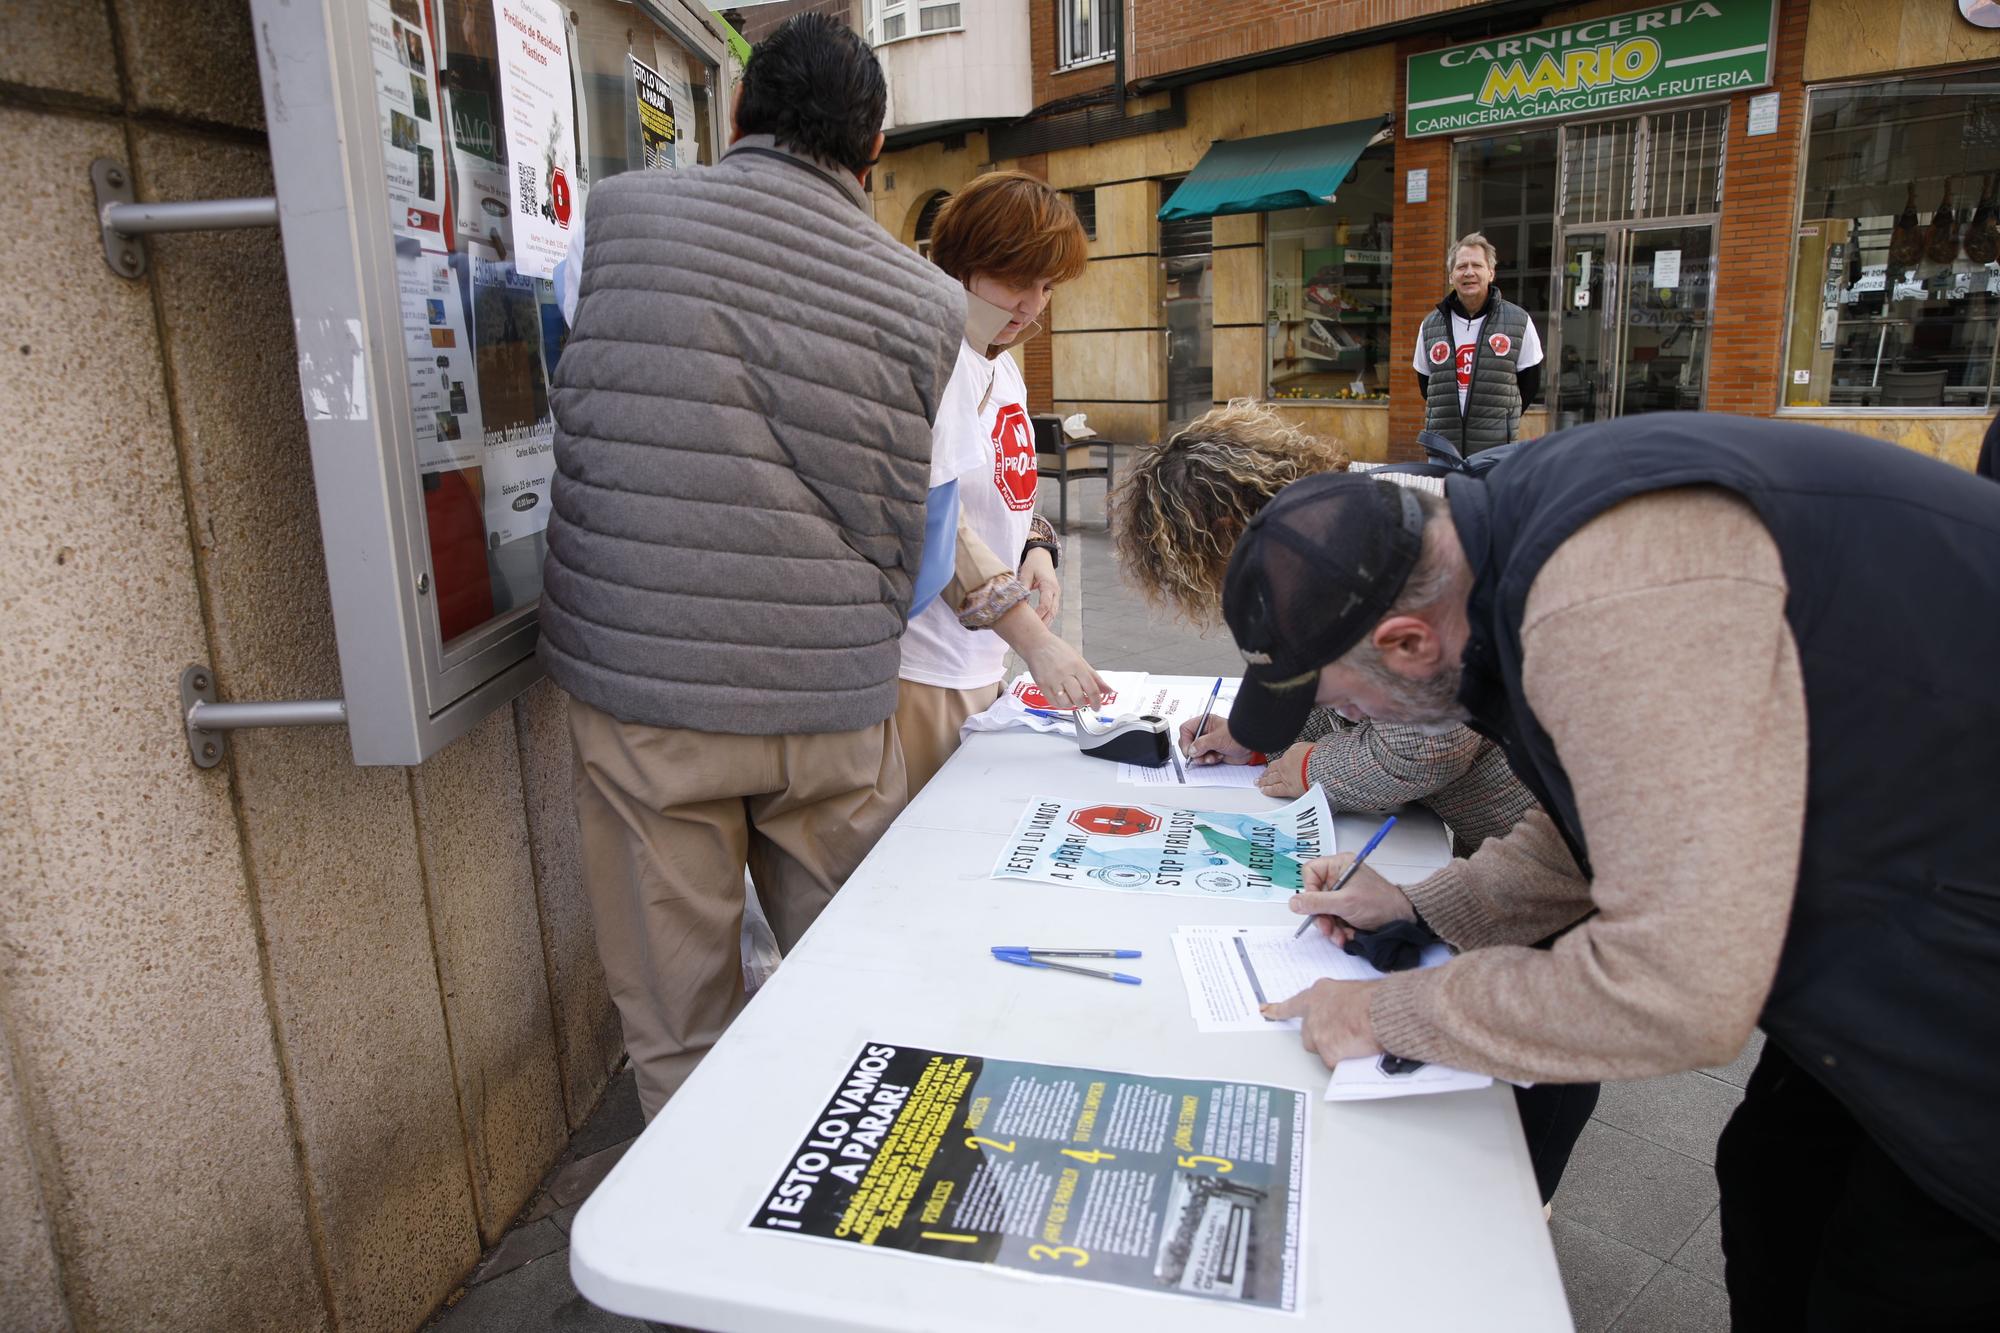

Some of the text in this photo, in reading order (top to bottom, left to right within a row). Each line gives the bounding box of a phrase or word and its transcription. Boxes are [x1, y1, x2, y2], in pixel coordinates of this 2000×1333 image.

[528, 25, 536, 39] de
[537, 30, 562, 56] Residuos
[1440, 2, 1722, 68] CARNICERIA
[522, 39, 548, 66] Plásticos
[1476, 35, 1661, 108] MARIO
[1415, 69, 1753, 133] CARNICERIA-CHARCUTERIA-FRUTERIA
[1005, 801, 1062, 873] ¡ESTO LO VAMOS
[1155, 812, 1196, 886] STOP PIRÓLISIS
[1296, 806, 1321, 860] QUEMAN
[1050, 832, 1090, 881] A PARAR!
[1245, 872, 1273, 888] TÚ
[927, 1054, 943, 1068] LA
[931, 1069, 946, 1083] EN
[934, 1061, 950, 1073] EL
[828, 1045, 896, 1115] VAMOS
[911, 1064, 940, 1097] CONTRA
[928, 1100, 946, 1114] DE
[807, 1118, 850, 1150] LO
[829, 1082, 909, 1184] A PARAR!
[890, 1121, 910, 1137] DE
[893, 1119, 921, 1153] PLANTA
[915, 1111, 938, 1143] MARZO
[867, 1133, 903, 1178] RECOGIDA
[902, 1152, 922, 1165] 26
[909, 1141, 927, 1155] DE
[962, 1134, 1016, 1153] 2
[1059, 1147, 1115, 1164] 4
[878, 1171, 892, 1185] DE
[882, 1198, 910, 1227] ZONA
[913, 1134, 940, 1168] ATENEO
[930, 1101, 955, 1137] OBRERO
[885, 1154, 902, 1174] UNA
[1176, 1154, 1233, 1173] 5
[861, 1174, 882, 1190] DE
[879, 1165, 913, 1210] DOMINGO
[834, 1187, 874, 1237] CAMPAÑA
[853, 1185, 890, 1236] APERTURA
[1027, 1243, 1089, 1268] 3
